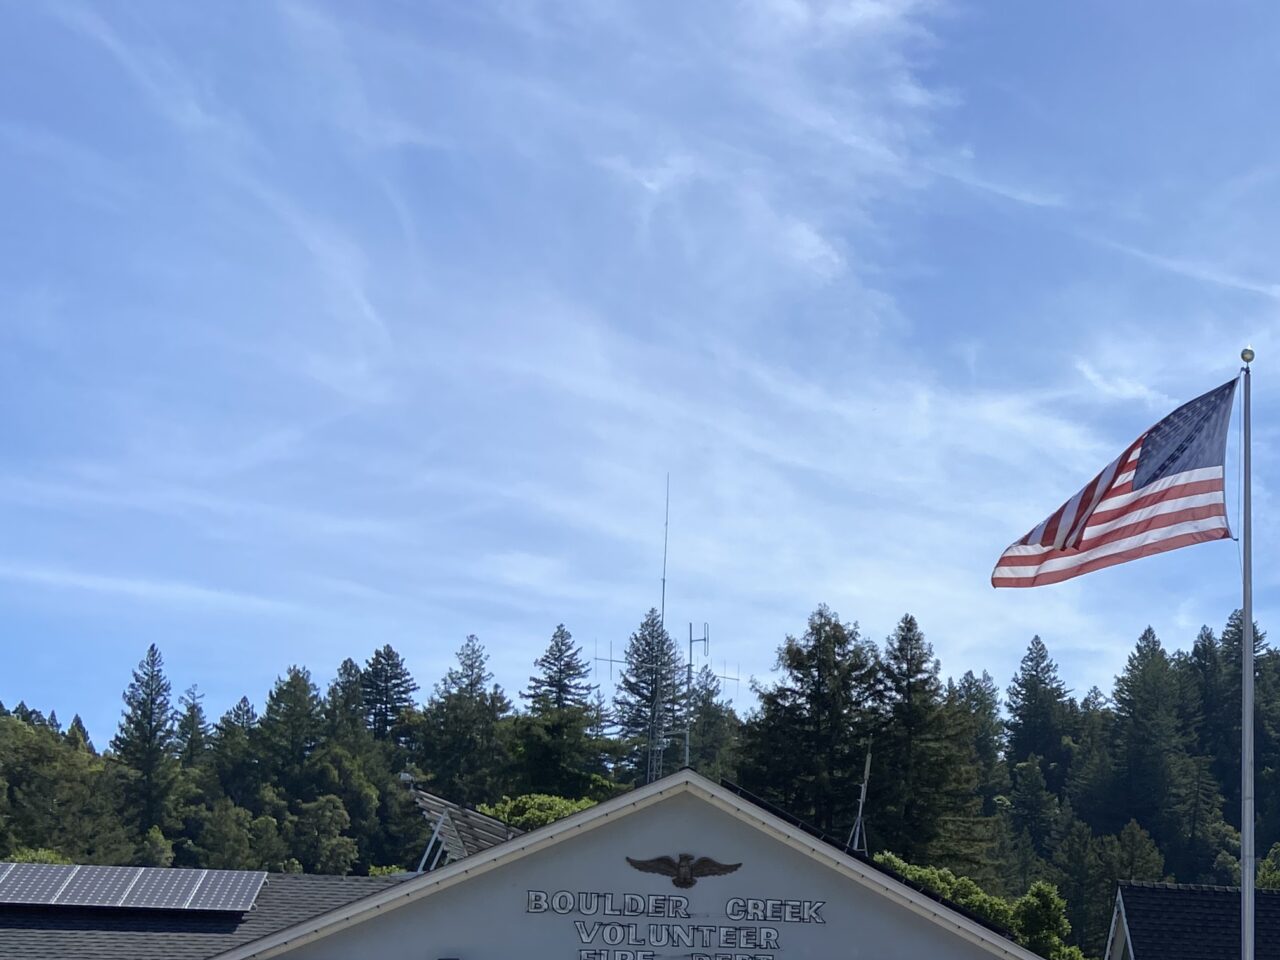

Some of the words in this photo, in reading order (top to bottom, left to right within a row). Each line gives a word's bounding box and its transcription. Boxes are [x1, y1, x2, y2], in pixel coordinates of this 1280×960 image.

[526, 890, 690, 919] BOULDER
[725, 898, 826, 923] CREEK
[574, 921, 780, 950] VOLUNTEER
